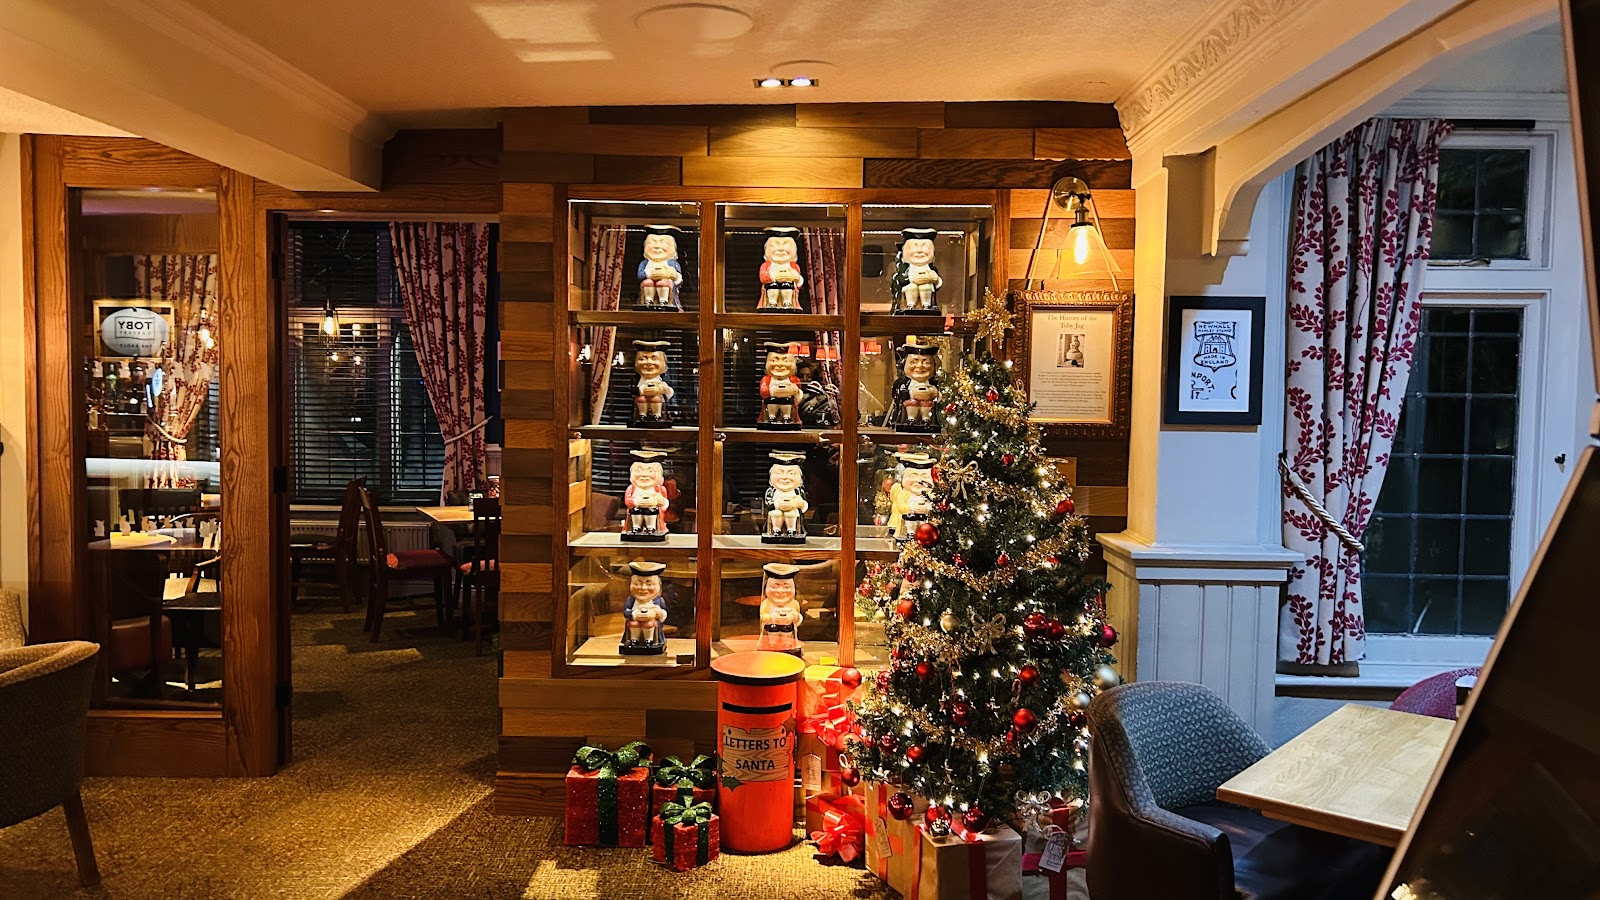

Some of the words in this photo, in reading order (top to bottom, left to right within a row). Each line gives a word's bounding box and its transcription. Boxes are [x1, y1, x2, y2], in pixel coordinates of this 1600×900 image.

[725, 736, 770, 751] LETTERS
[773, 737, 787, 749] TO
[735, 759, 775, 770] SANTA
